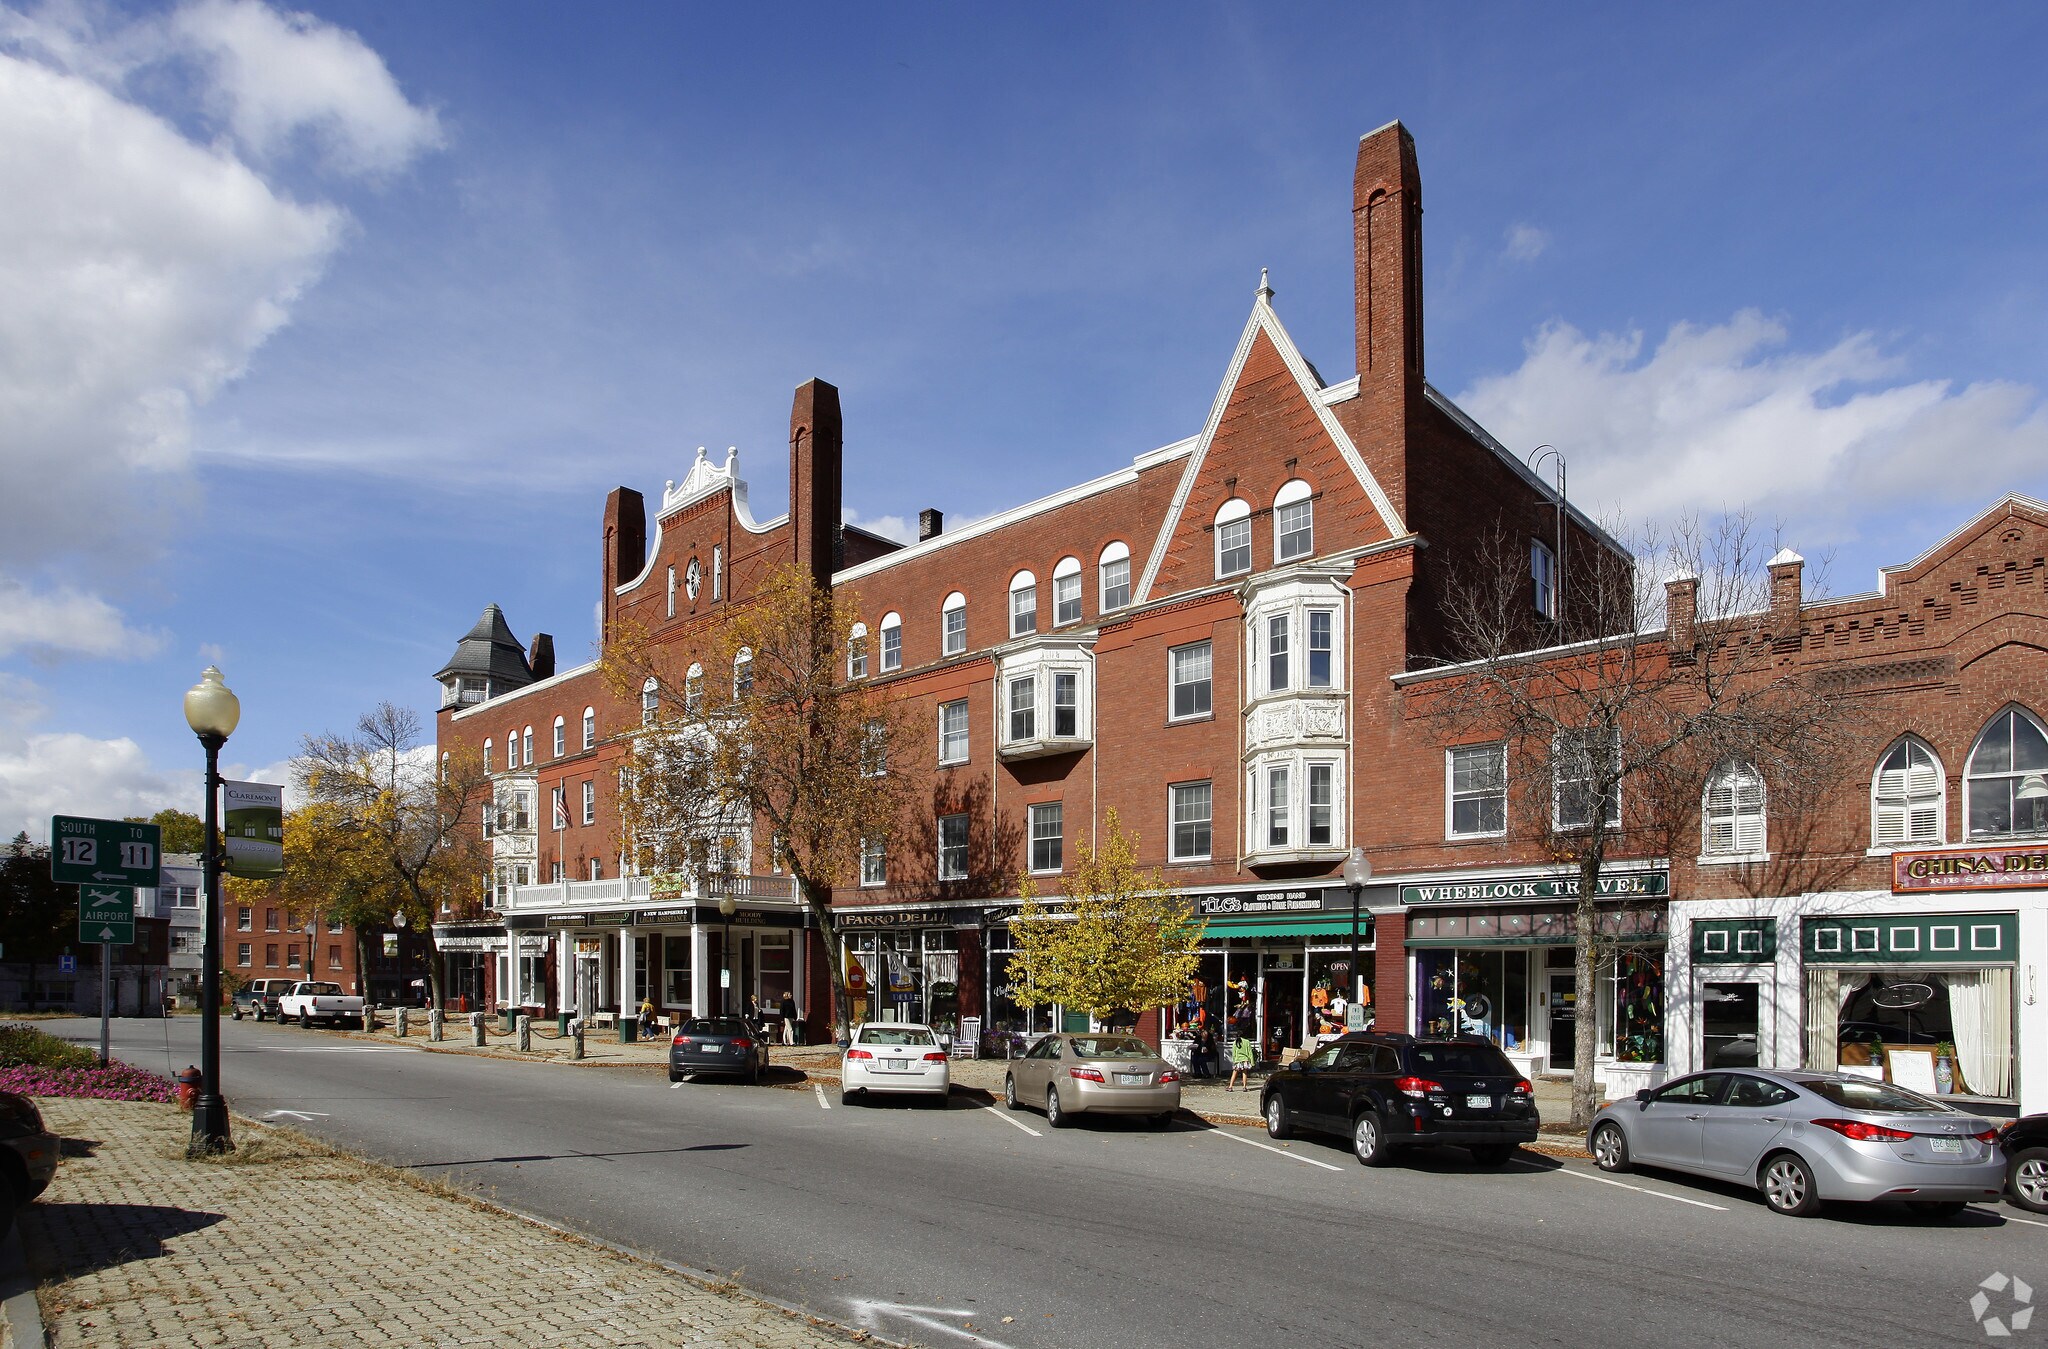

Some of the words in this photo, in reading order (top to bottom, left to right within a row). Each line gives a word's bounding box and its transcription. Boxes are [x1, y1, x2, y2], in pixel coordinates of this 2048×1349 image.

[60, 821, 96, 835] SOUTH
[130, 828, 143, 839] TO
[68, 840, 92, 862] 12
[233, 842, 276, 853] Welcome
[129, 845, 147, 866] 11
[1907, 855, 1997, 879] CHINA
[2004, 854, 2048, 873] DE
[1418, 882, 1538, 901] WHEELOCK
[1551, 878, 1647, 896] TRVEL
[1257, 893, 1285, 901] SECOND
[1286, 891, 1307, 900] HAND
[1017, 906, 1048, 915] BOK
[1272, 900, 1287, 911] HOME
[85, 911, 129, 921] AIRPORT
[657, 914, 688, 923] ASSISTANCE
[658, 909, 684, 917] HAMPSHIRE
[735, 917, 766, 925] BUILDING
[845, 914, 895, 926] FARRO
[899, 912, 938, 923] DELI
[61, 956, 74, 969] H
[1330, 962, 1350, 971] OPEN
